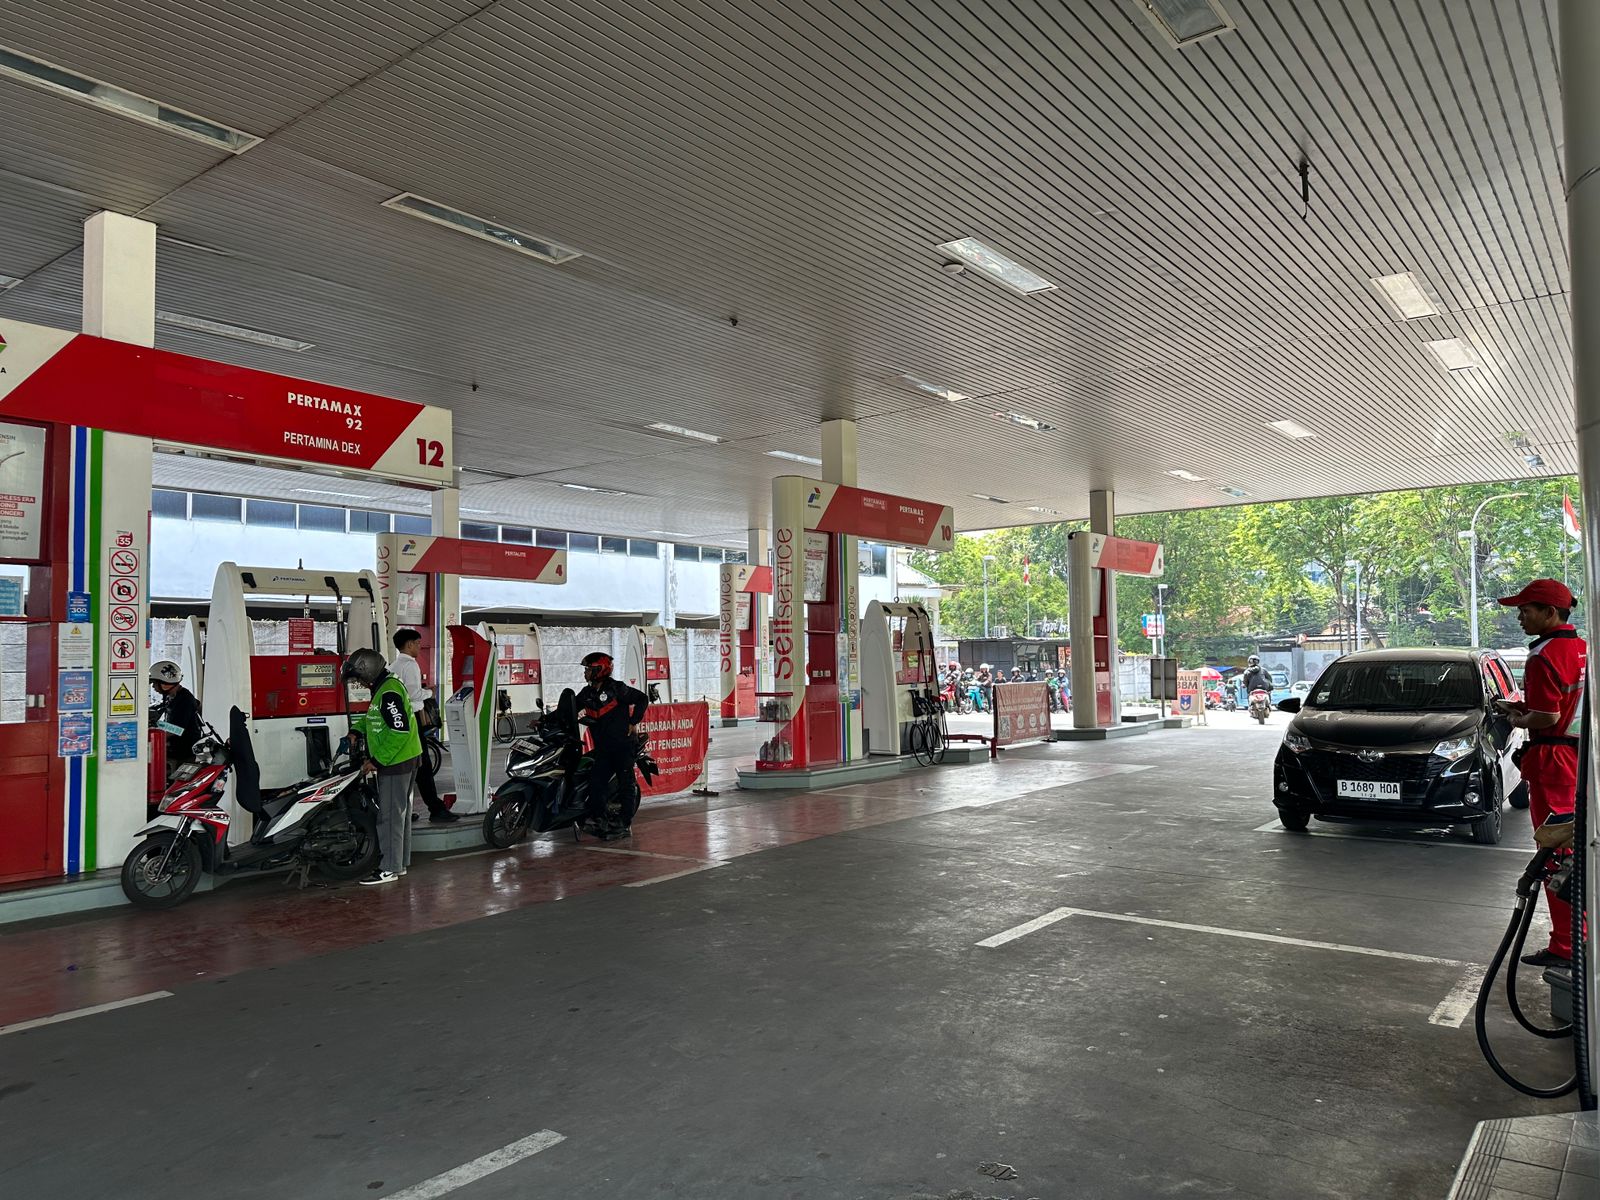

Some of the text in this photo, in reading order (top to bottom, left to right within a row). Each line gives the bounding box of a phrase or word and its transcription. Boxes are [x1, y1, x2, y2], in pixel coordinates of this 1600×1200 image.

[287, 391, 363, 417] PERTAMAX
[345, 417, 363, 431] 92
[283, 431, 361, 455] PERTAMINA DEX
[415, 436, 444, 468] 12
[899, 505, 924, 517] PERTAMAX
[940, 524, 952, 542] 10
[504, 550, 526, 558] PERTALITE
[555, 564, 563, 577] 4
[386, 700, 405, 729] gojek
[636, 719, 694, 733] KENDARAAN ANDA
[658, 737, 692, 750] PENGISIAN
[1342, 781, 1399, 794] B 1689 HOA
